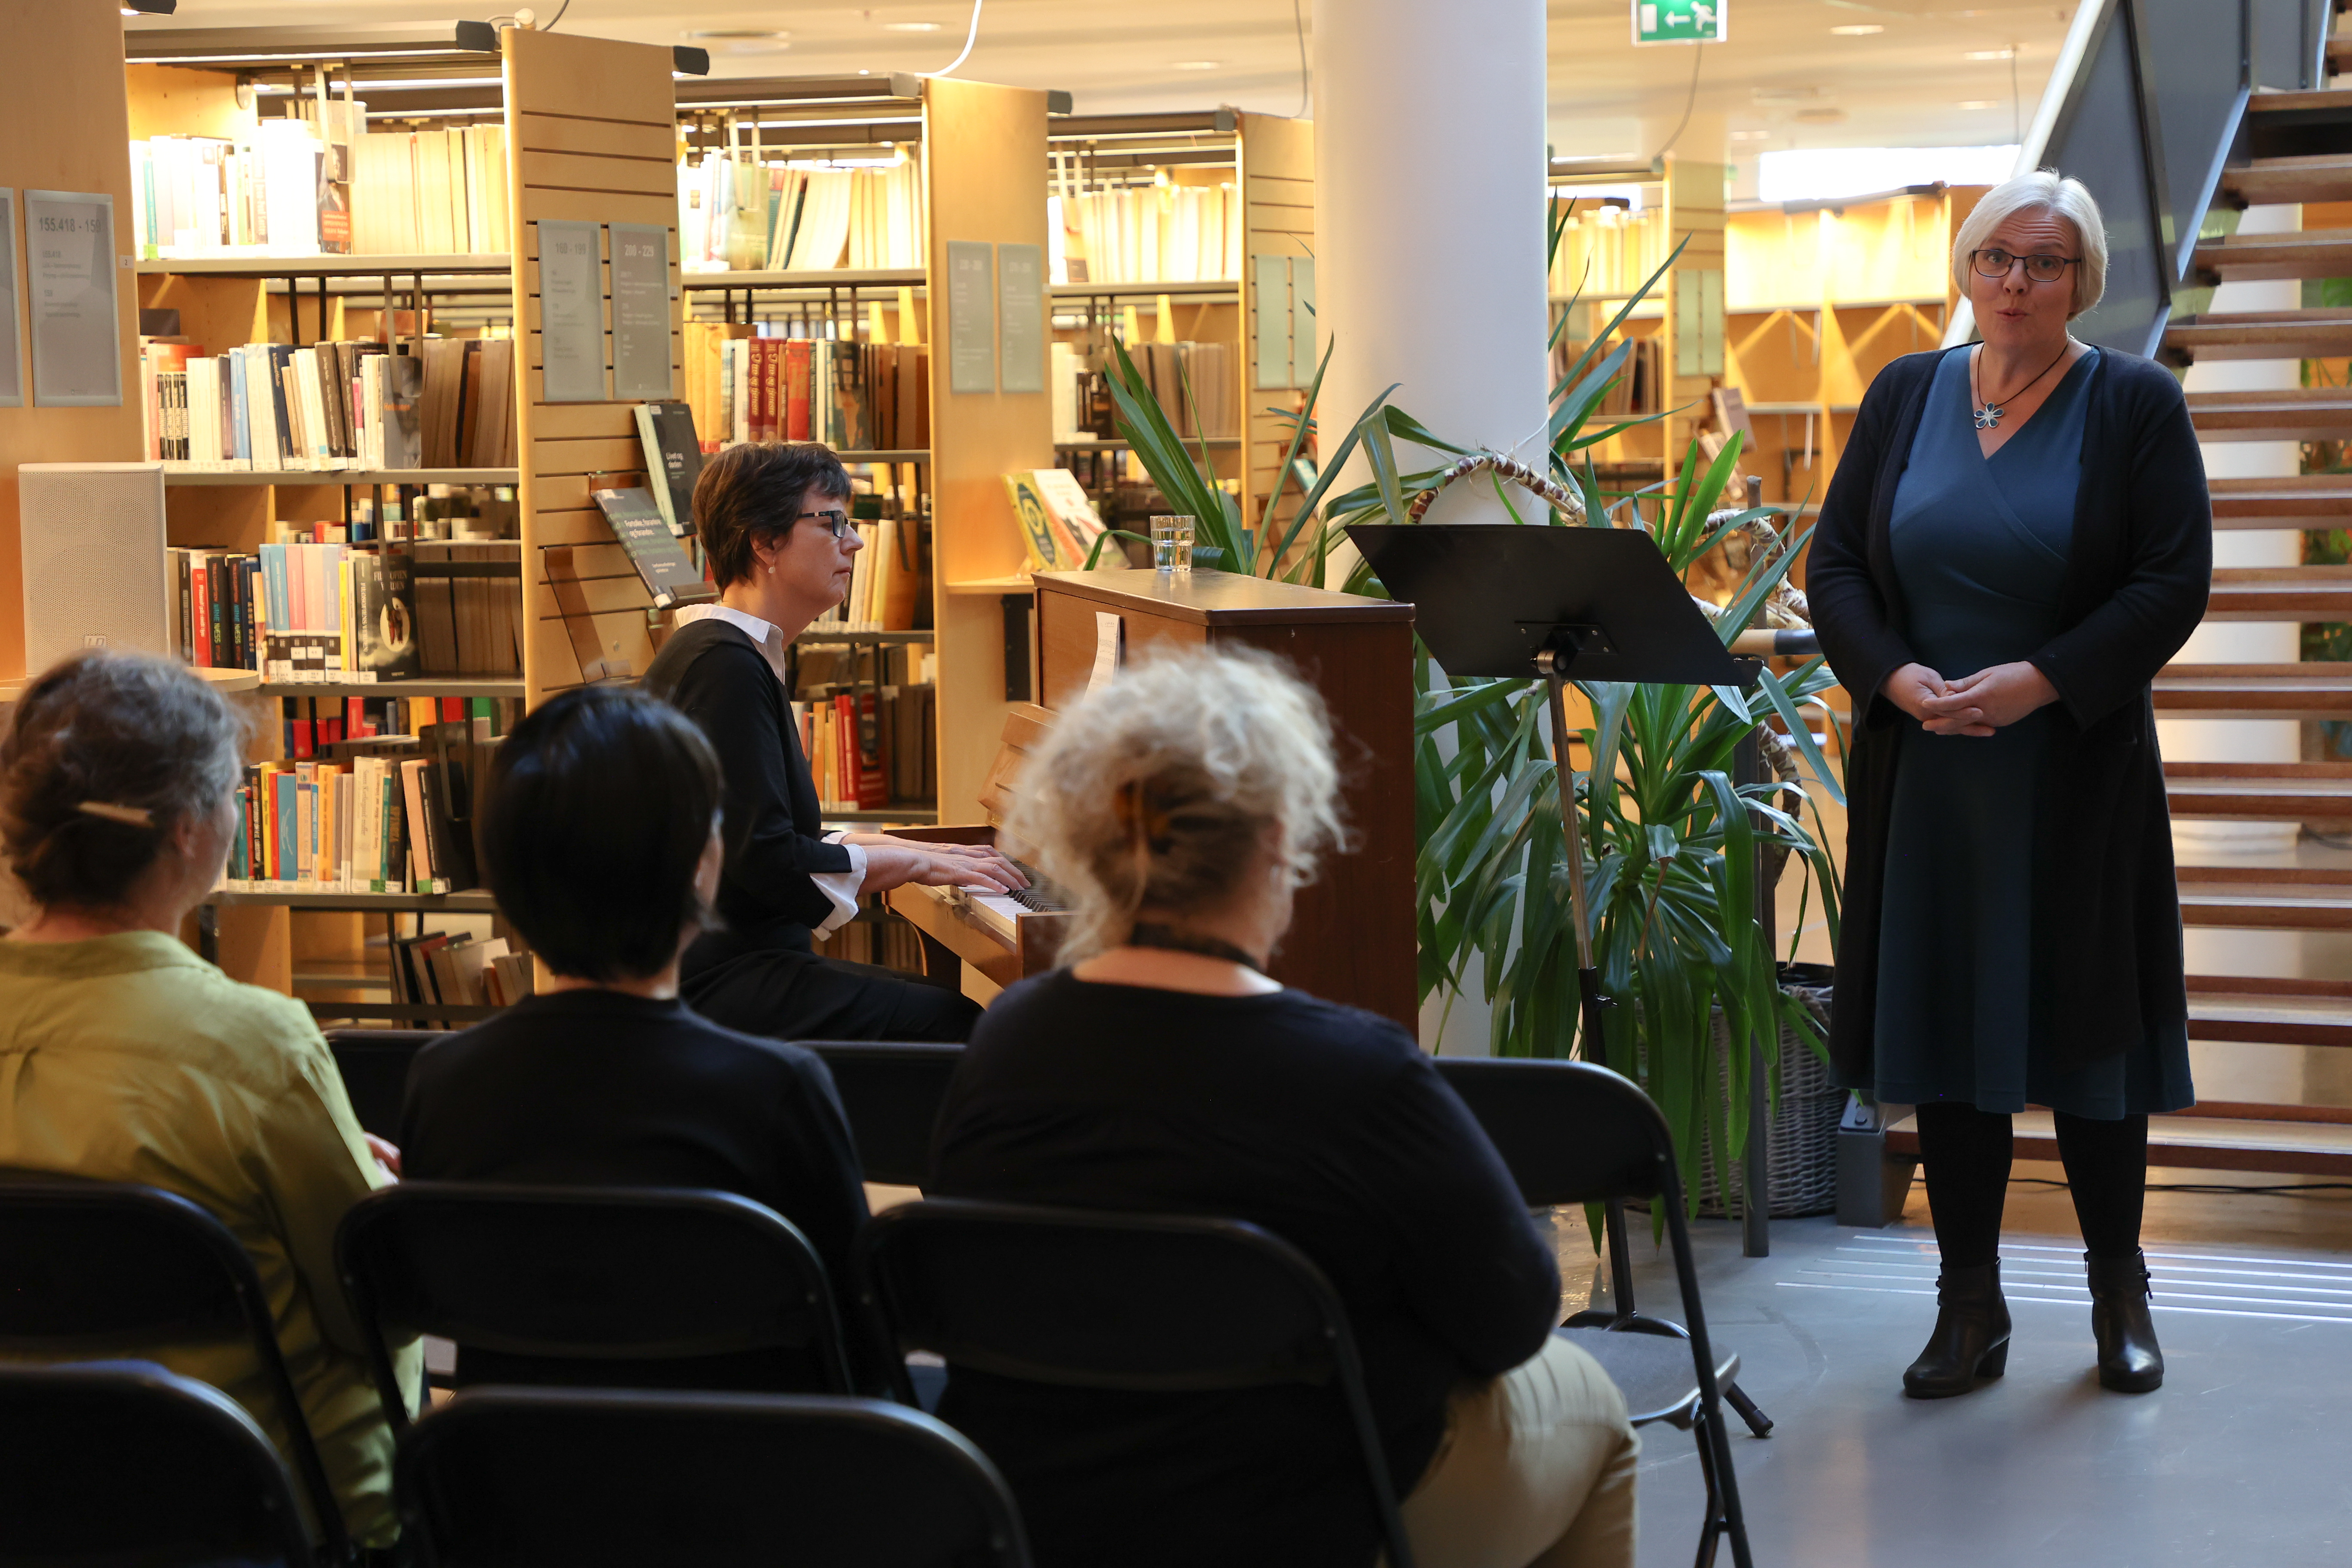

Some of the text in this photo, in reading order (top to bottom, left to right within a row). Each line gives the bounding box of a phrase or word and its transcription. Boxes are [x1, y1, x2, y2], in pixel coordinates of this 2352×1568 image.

[39, 217, 75, 233] 155.418
[85, 219, 102, 233] 159
[124, 258, 128, 266] 2
